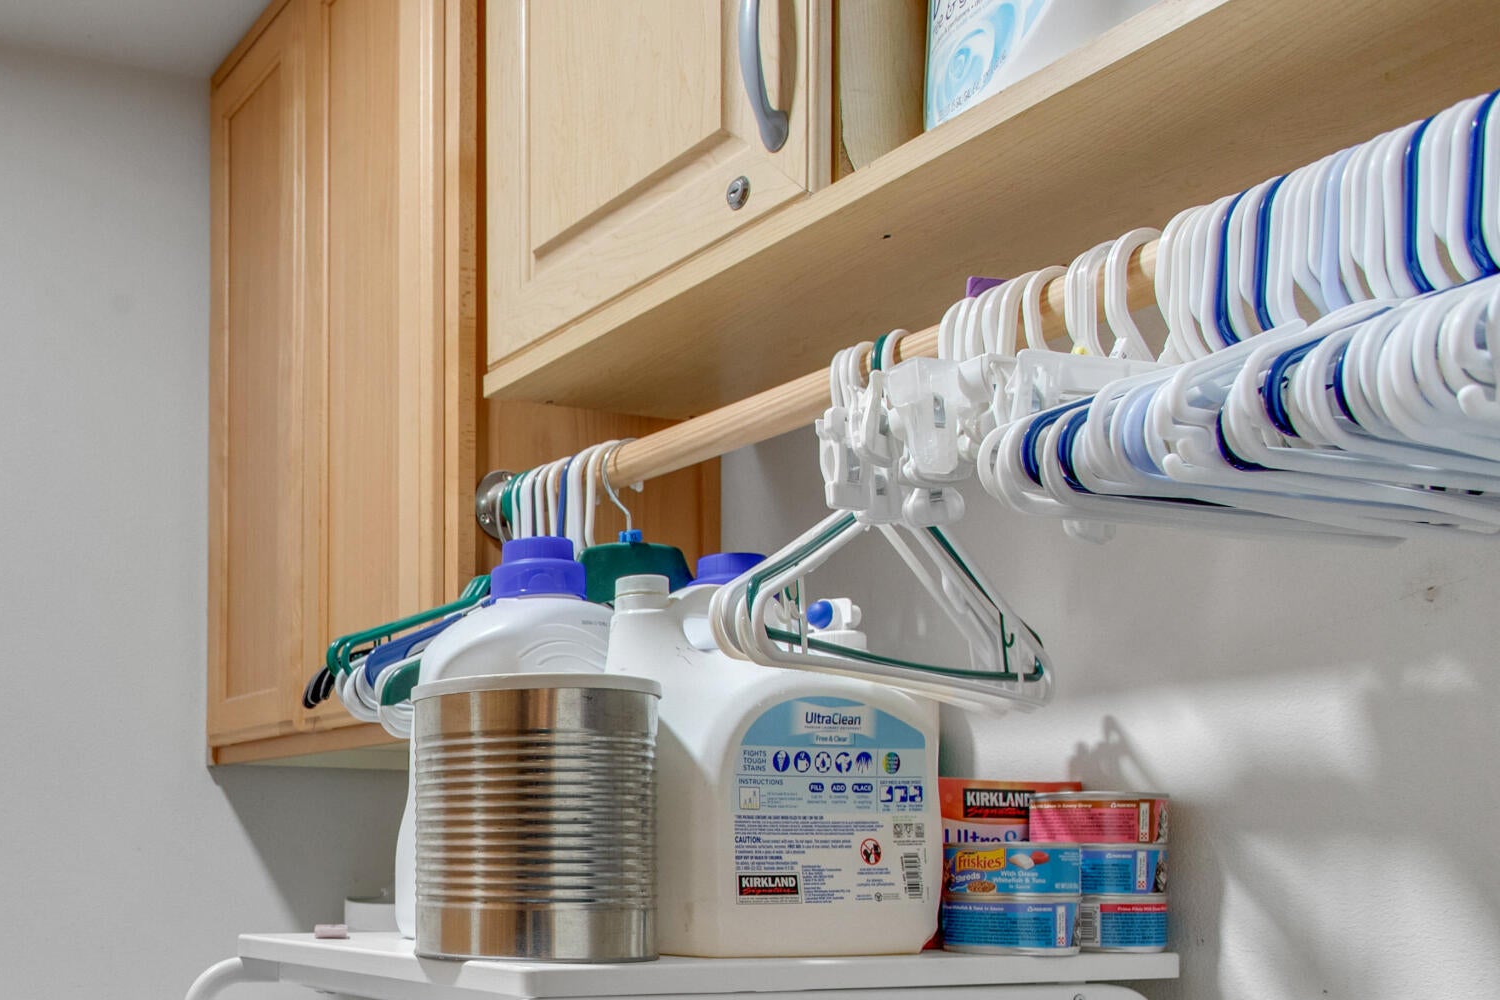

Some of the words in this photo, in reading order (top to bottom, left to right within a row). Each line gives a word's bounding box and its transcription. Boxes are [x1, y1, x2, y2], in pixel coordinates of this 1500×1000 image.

[804, 711, 861, 726] UltraClean
[743, 750, 767, 758] FIGHTS
[743, 757, 767, 765] TOUGH
[743, 764, 766, 772] STAINS
[810, 784, 824, 792] FILL
[832, 784, 846, 792] ADD
[853, 784, 872, 792] PLACE
[958, 854, 1002, 869] Friskies
[741, 877, 796, 888] KIRKLAND
